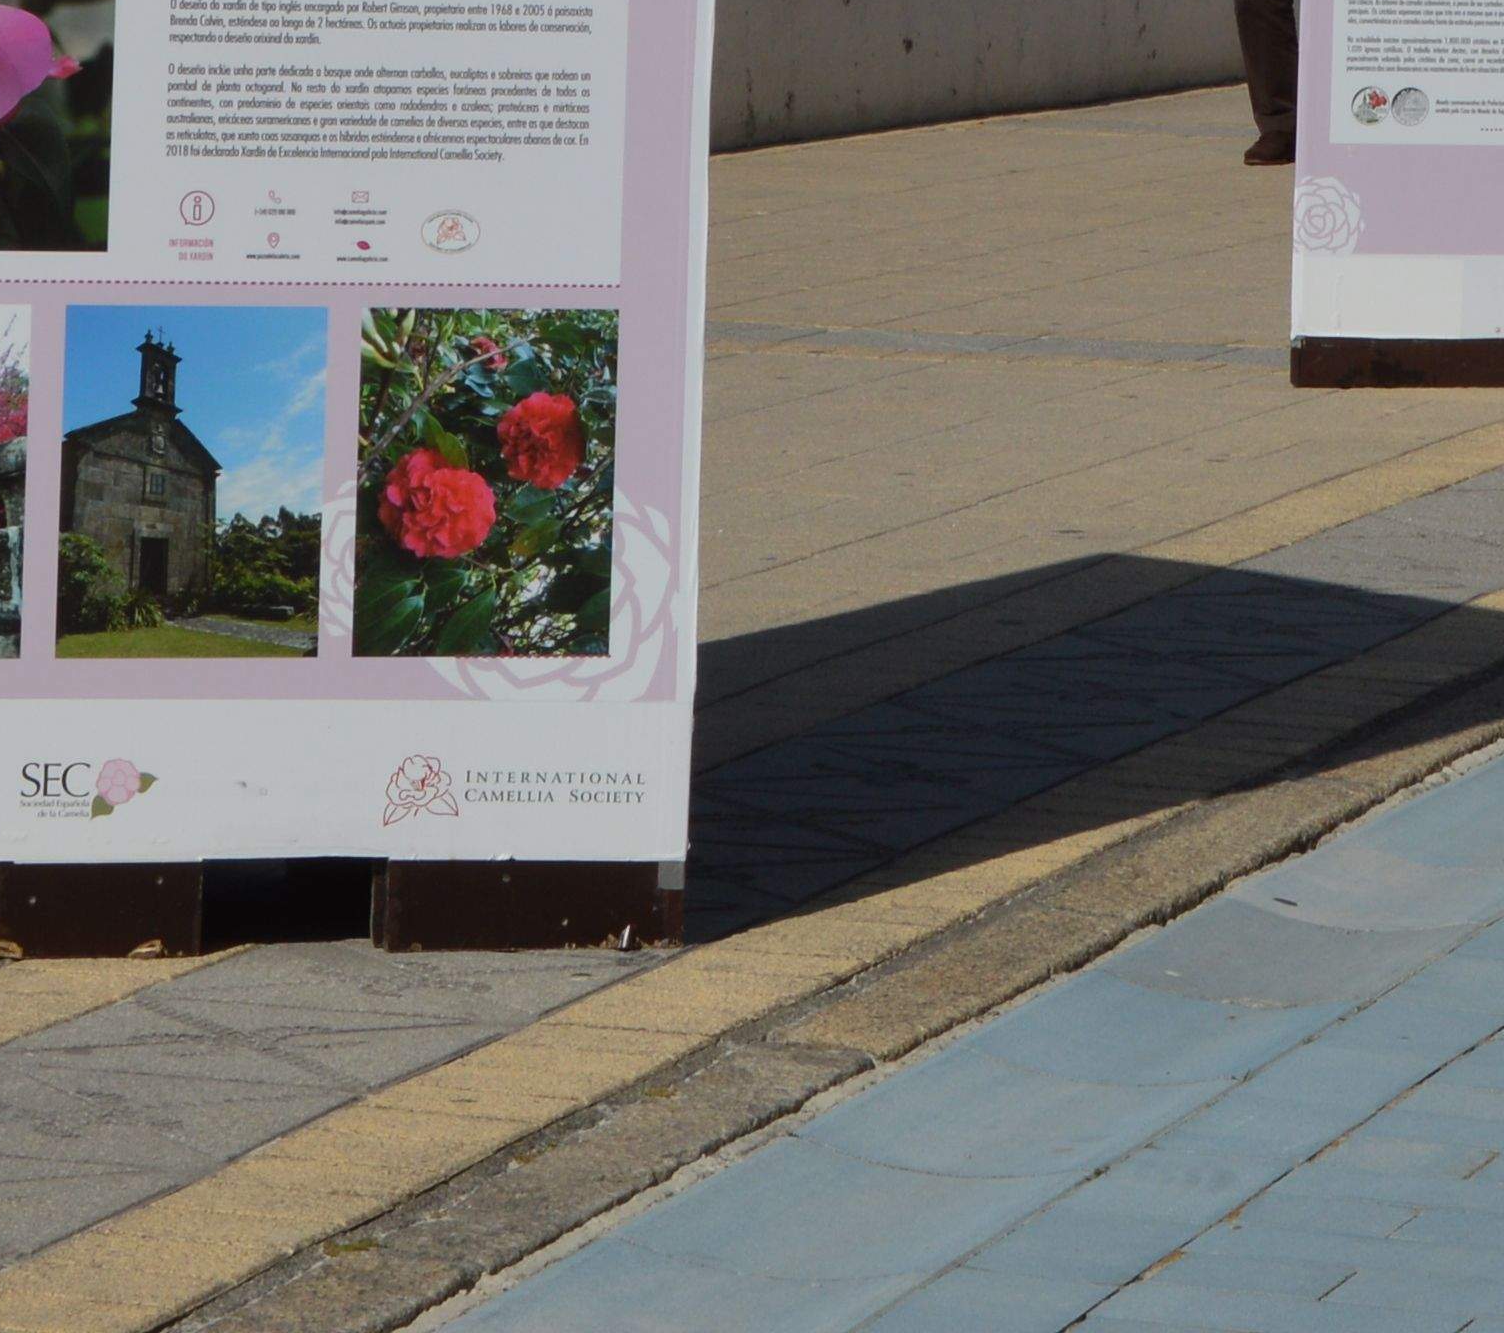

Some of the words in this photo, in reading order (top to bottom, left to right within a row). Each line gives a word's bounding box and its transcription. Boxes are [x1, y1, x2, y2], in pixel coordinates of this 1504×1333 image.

[20, 762, 91, 798] SEC
[465, 769, 646, 785] INTERNATIONAL
[464, 788, 554, 804] CAMELLIA
[569, 788, 646, 804] SOCIETY
